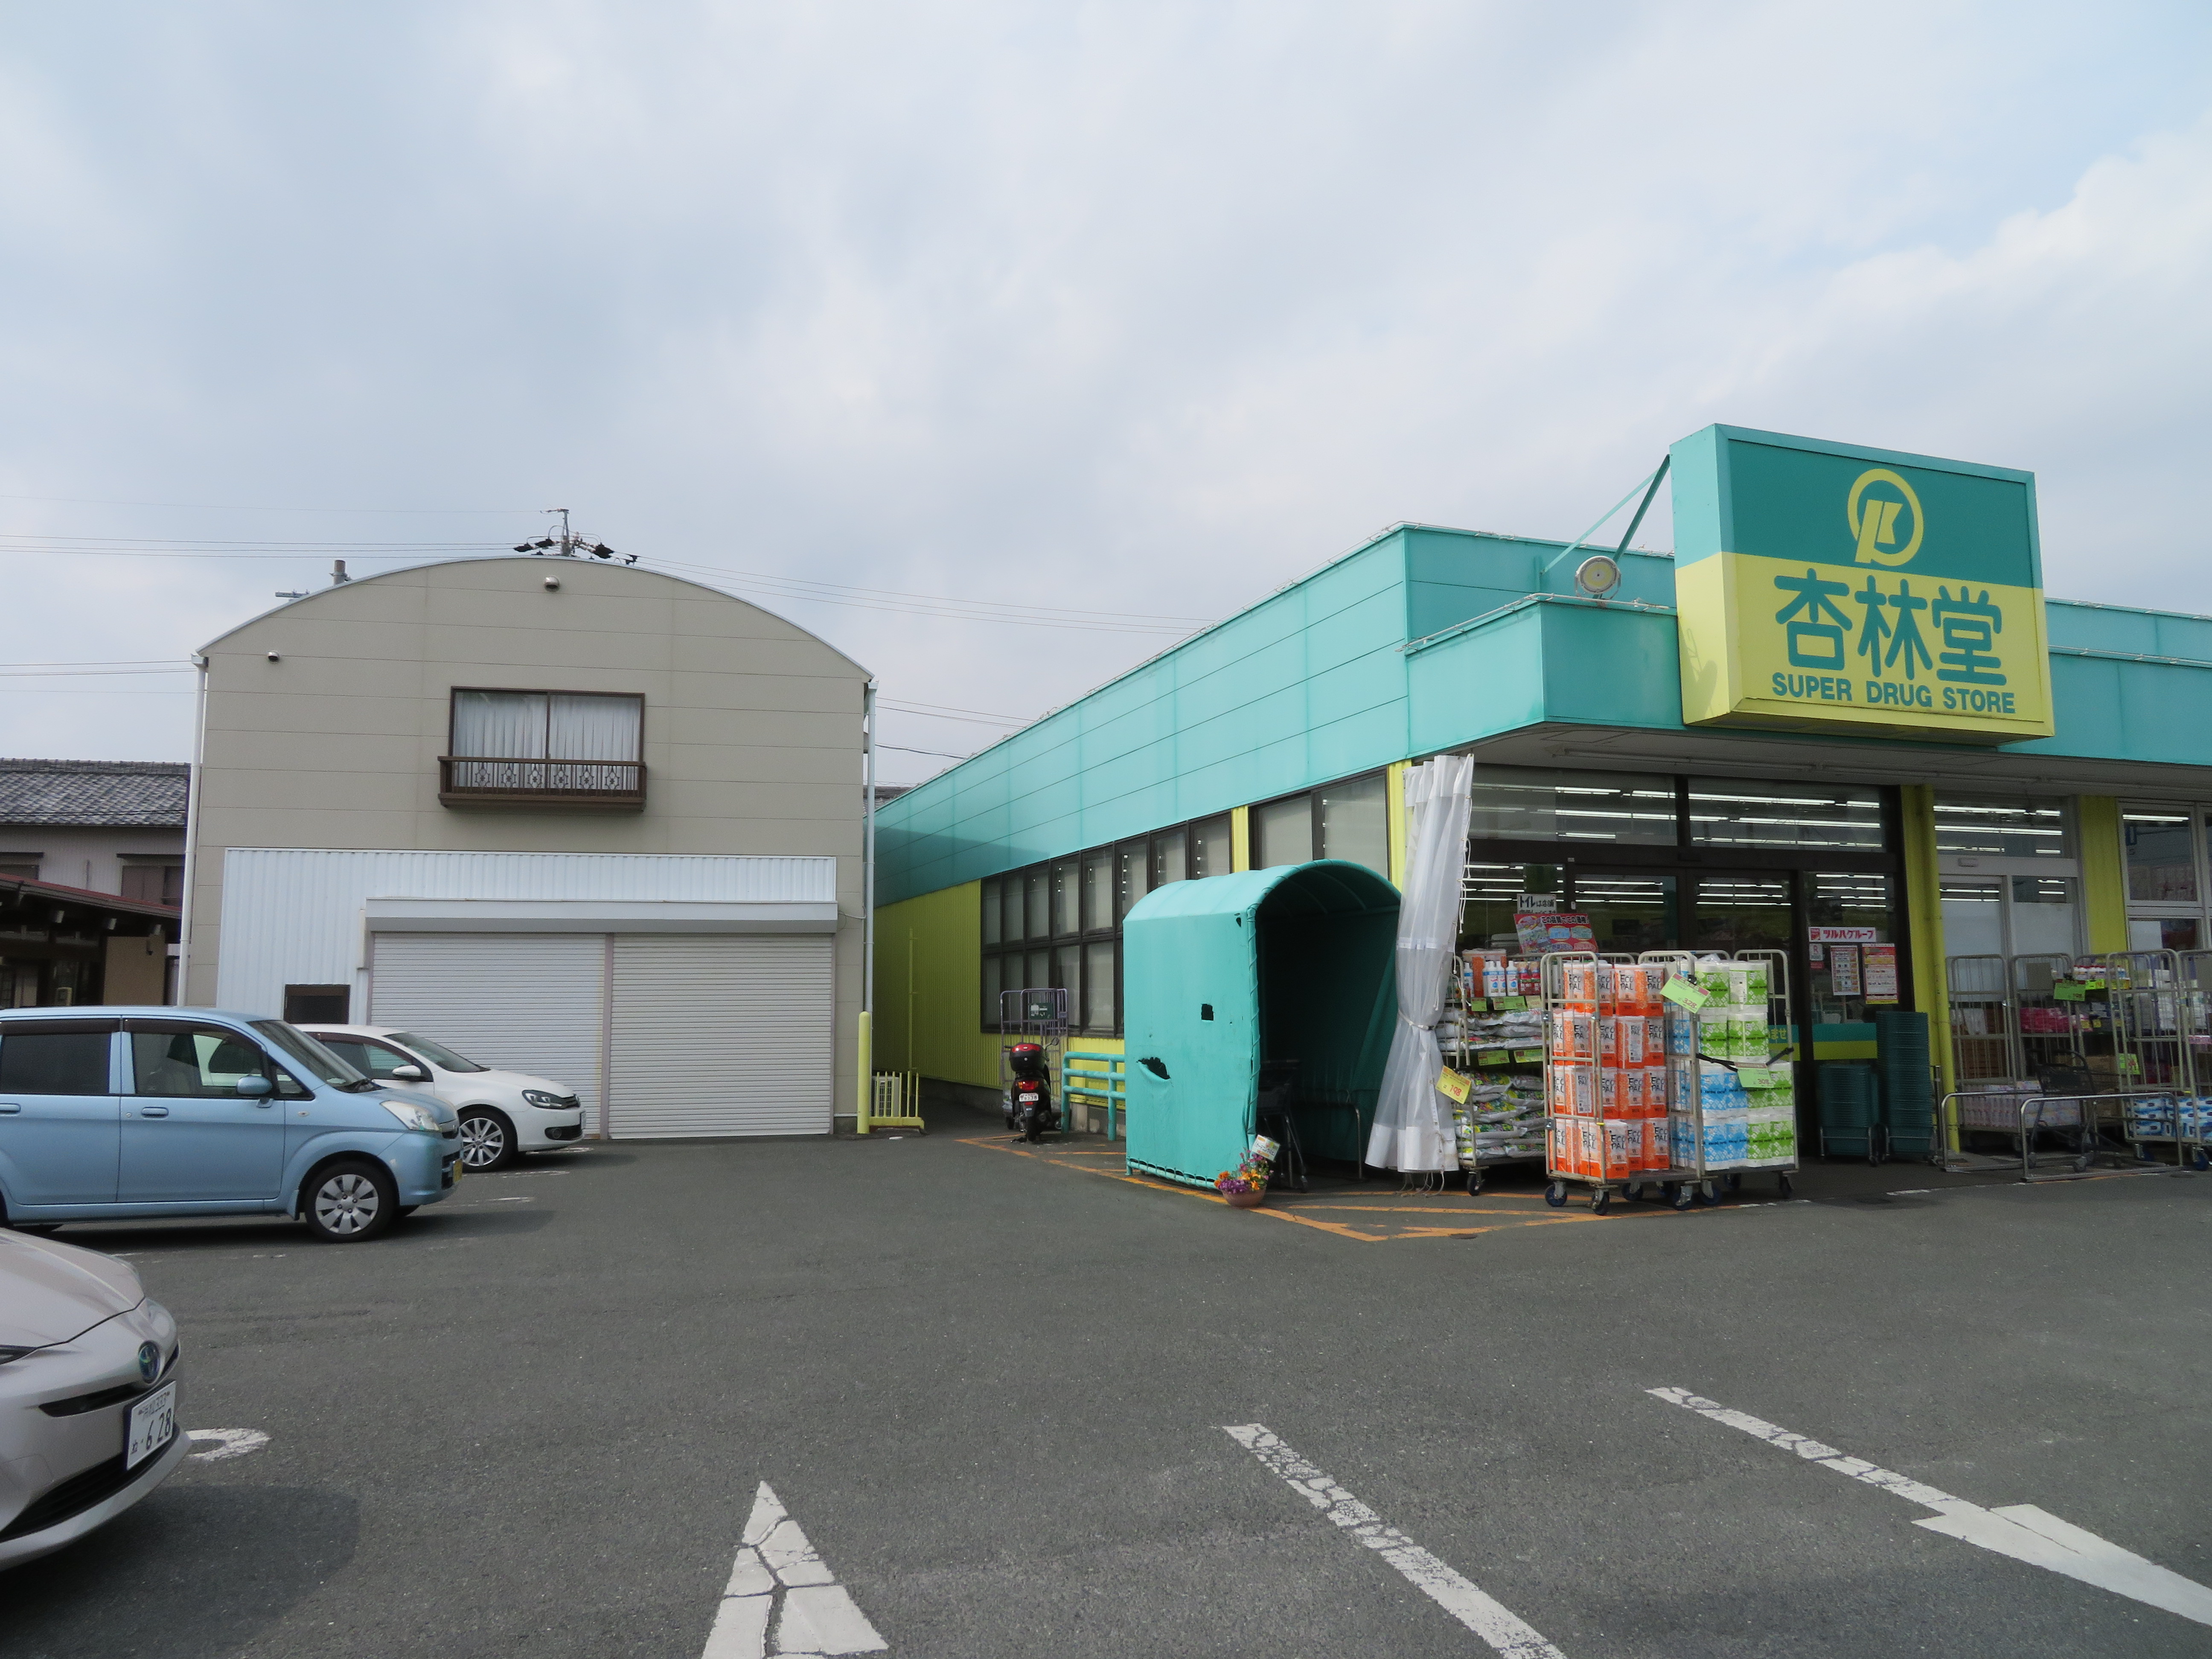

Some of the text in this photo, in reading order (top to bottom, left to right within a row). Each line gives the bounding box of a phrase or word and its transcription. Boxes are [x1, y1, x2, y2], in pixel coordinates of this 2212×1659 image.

[1773, 568, 2007, 687] 杏林堂
[1772, 672, 2016, 714] SUPER DRUG STORE
[1823, 929, 1874, 939] ツルハグループ
[1620, 974, 1634, 982] ECO
[1647, 974, 1661, 982] ECO
[1654, 1127, 1668, 1135] ECO
[1611, 1134, 1626, 1142] ECO
